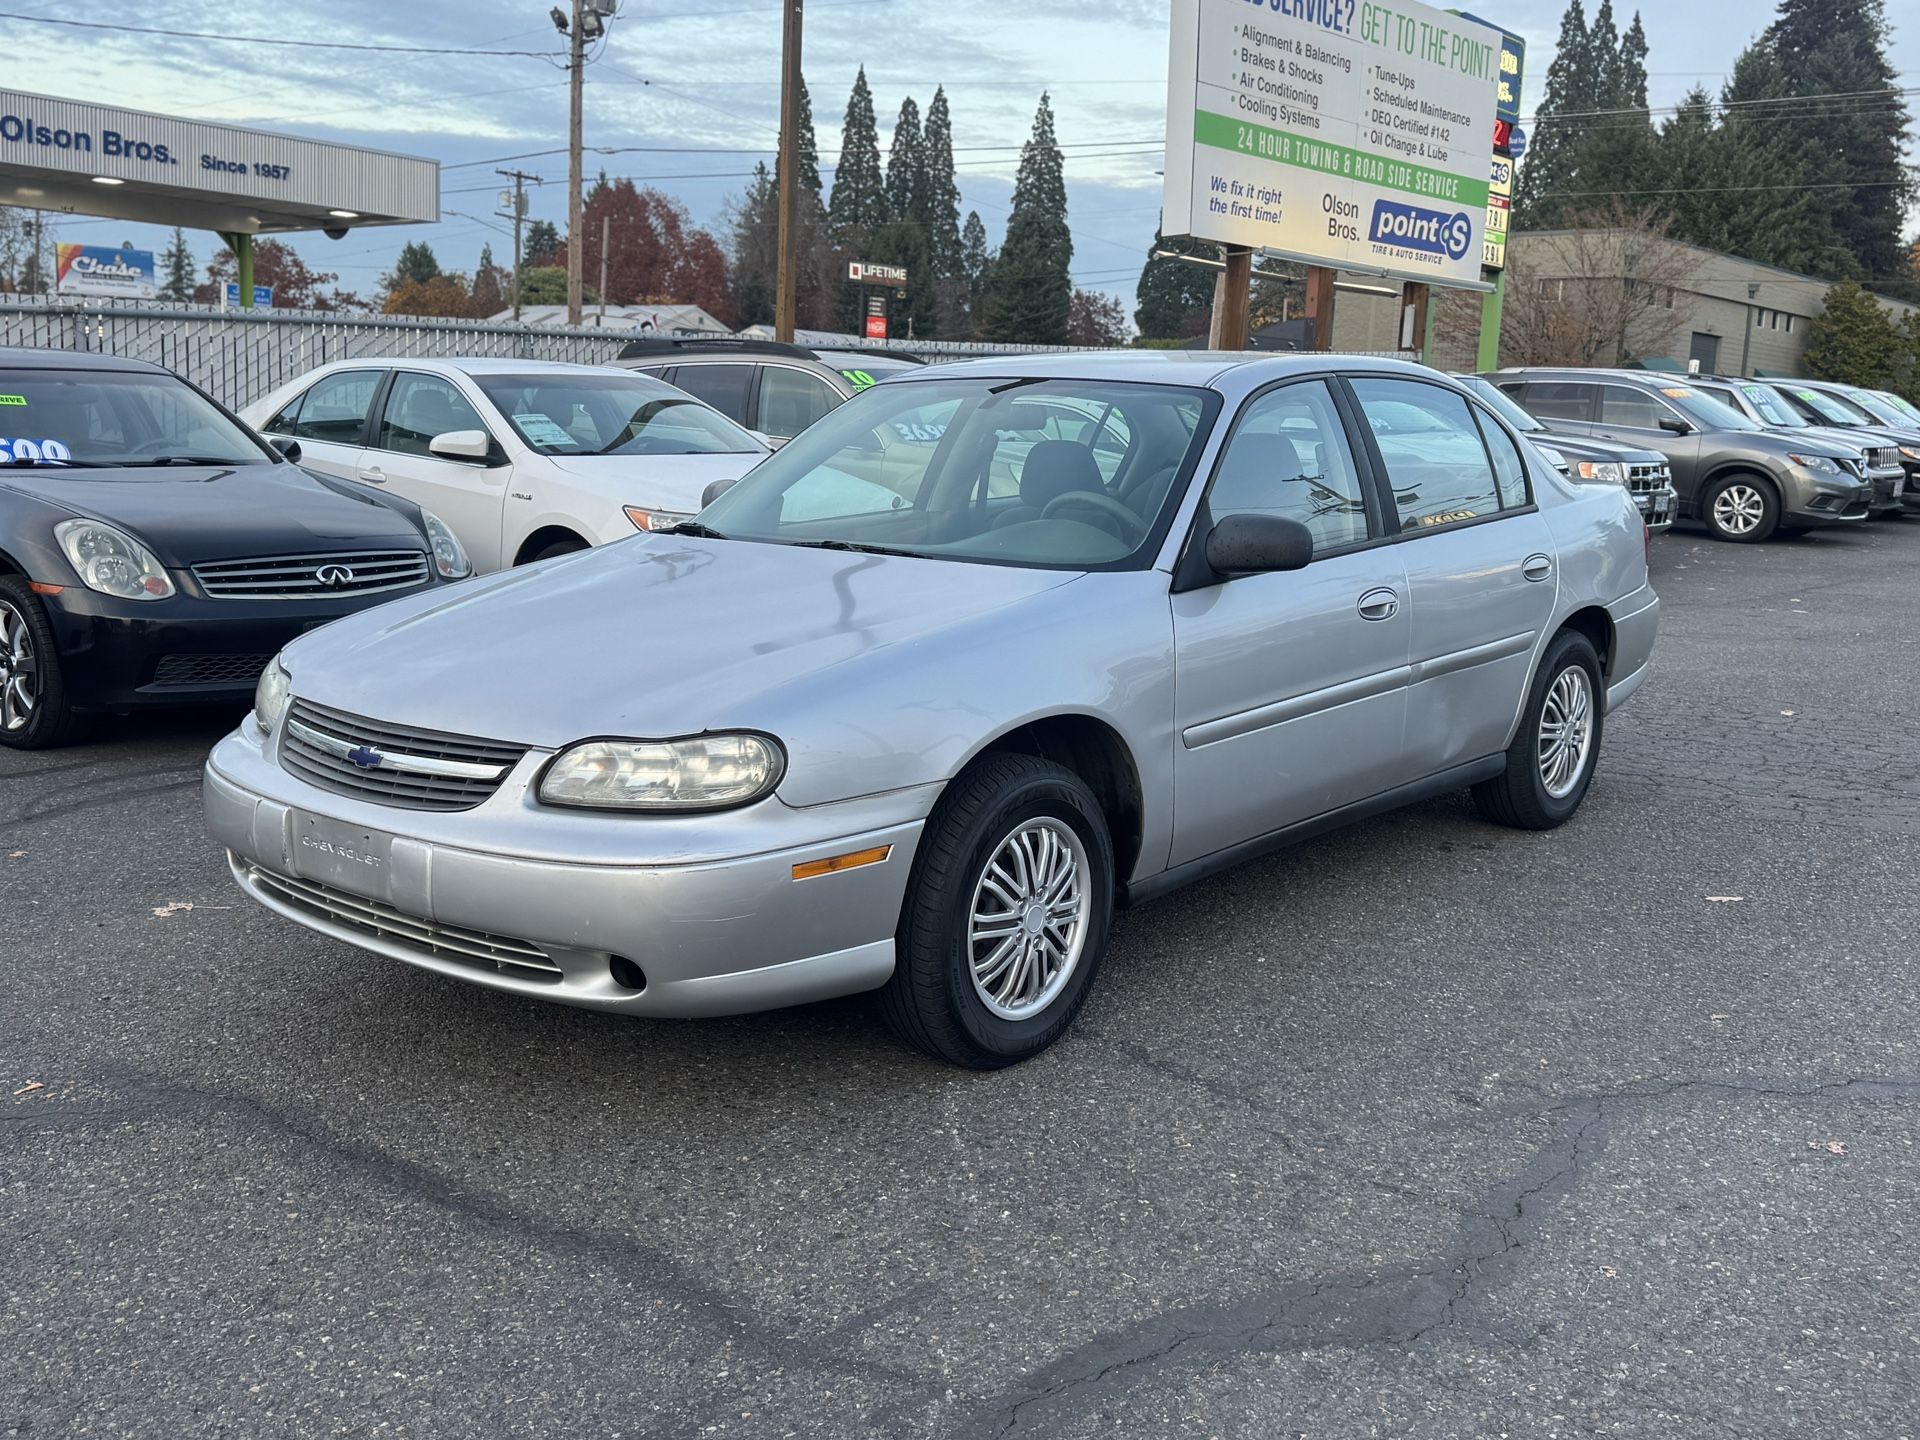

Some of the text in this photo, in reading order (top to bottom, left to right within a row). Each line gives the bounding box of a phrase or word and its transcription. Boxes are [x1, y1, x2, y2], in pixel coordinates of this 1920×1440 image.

[1242, 24, 1351, 73] Alignment & Balancing
[1361, 2, 1392, 47] GET
[1396, 14, 1415, 55] TO
[1420, 22, 1448, 66] THE
[1451, 33, 1494, 82] POINT.
[1241, 48, 1323, 84] Brakes & Shocks
[1375, 65, 1415, 90] Tune-Ups
[1240, 72, 1318, 110] Air Conditioning
[1373, 87, 1470, 126] Scheduled Maintenance
[1239, 94, 1320, 128] Cooling Systems
[1372, 109, 1450, 141] DEQ Certified #142
[0, 115, 290, 181] Olson Bros. Since 1957
[1370, 130, 1448, 161] Oil Change & Lube
[1238, 126, 1459, 198] 24 HOUR TOWING & ROAD SIDE SERVICE
[1211, 175, 1282, 205] We fix it right
[1322, 193, 1359, 219] Olson
[1209, 197, 1282, 224] the first time!
[1377, 211, 1439, 242] point
[1328, 217, 1360, 241] Bros.
[1372, 244, 1443, 265] TIRE & AUTO SERVICE
[862, 264, 907, 280] LIFETIME
[302, 835, 381, 867] CHEVROLET
